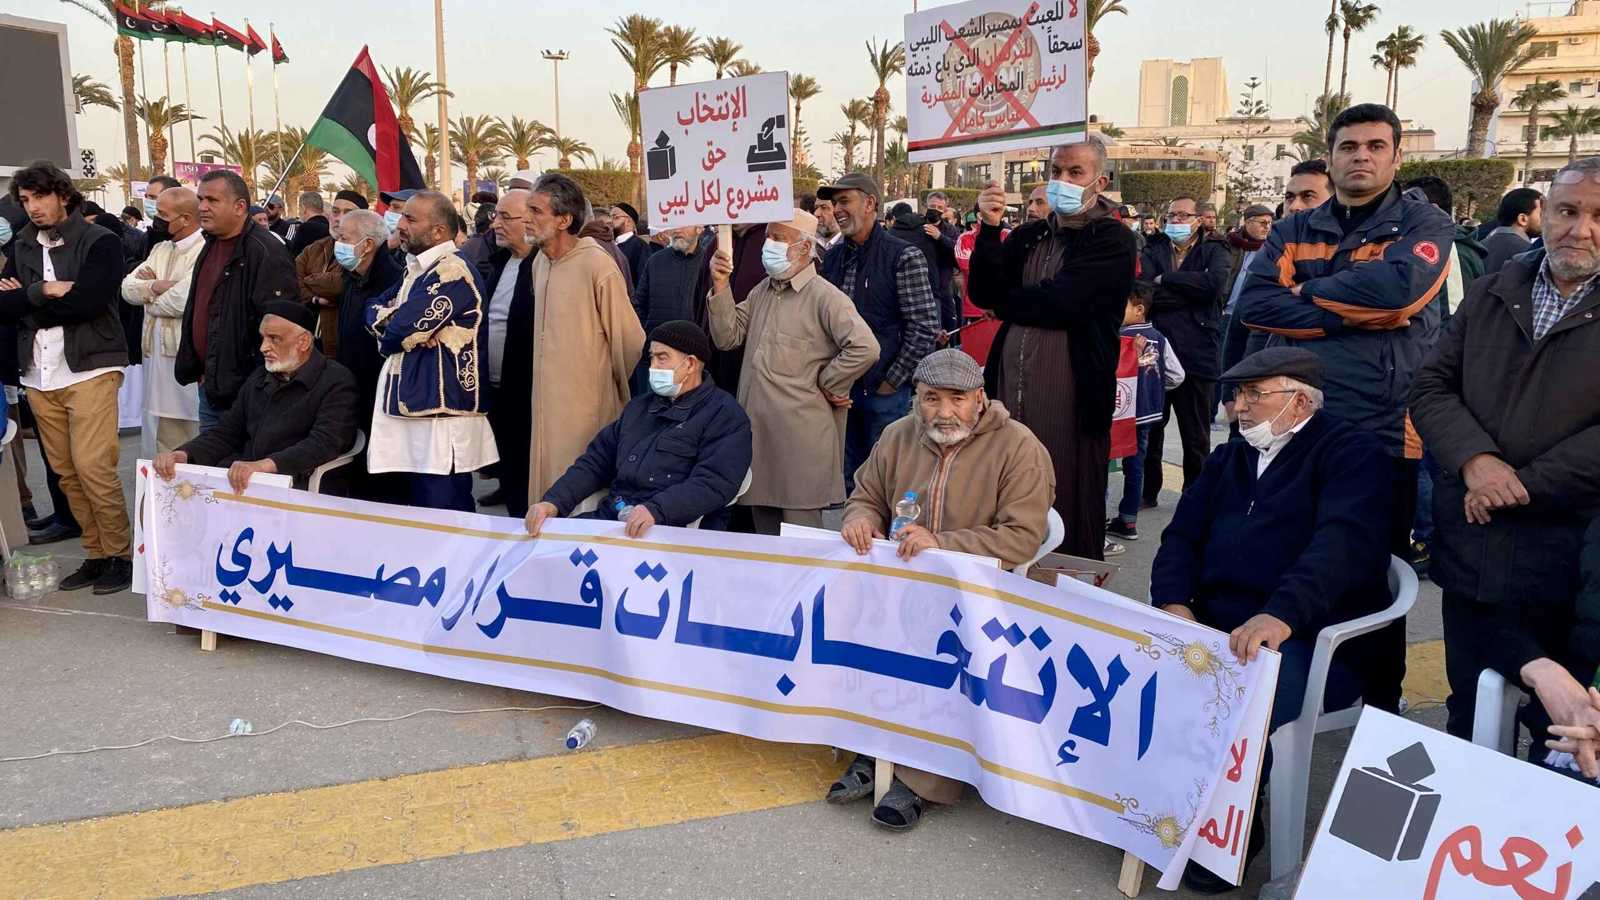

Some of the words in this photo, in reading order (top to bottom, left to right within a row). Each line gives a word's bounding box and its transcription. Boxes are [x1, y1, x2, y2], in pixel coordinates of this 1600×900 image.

[1026, 1, 1064, 30] للعبث
[909, 25, 942, 58] الليبي
[907, 55, 932, 77] ذمته
[935, 53, 950, 83] باع
[953, 48, 980, 78] الذي
[1028, 64, 1067, 94] لرئيس
[921, 79, 965, 109] المصرية
[968, 70, 1024, 100] المخابرات
[677, 84, 748, 136] الإنتخاب
[958, 110, 986, 133] كامل
[702, 140, 727, 171] حق
[658, 180, 689, 223] ليبي
[694, 178, 721, 213] لكل
[726, 174, 779, 220] مشروع
[216, 527, 446, 612] مصيري
[442, 547, 604, 640] قرار
[612, 562, 1158, 765] الإنتخابات
[1226, 738, 1248, 783] لا
[1423, 824, 1584, 900] نعم
